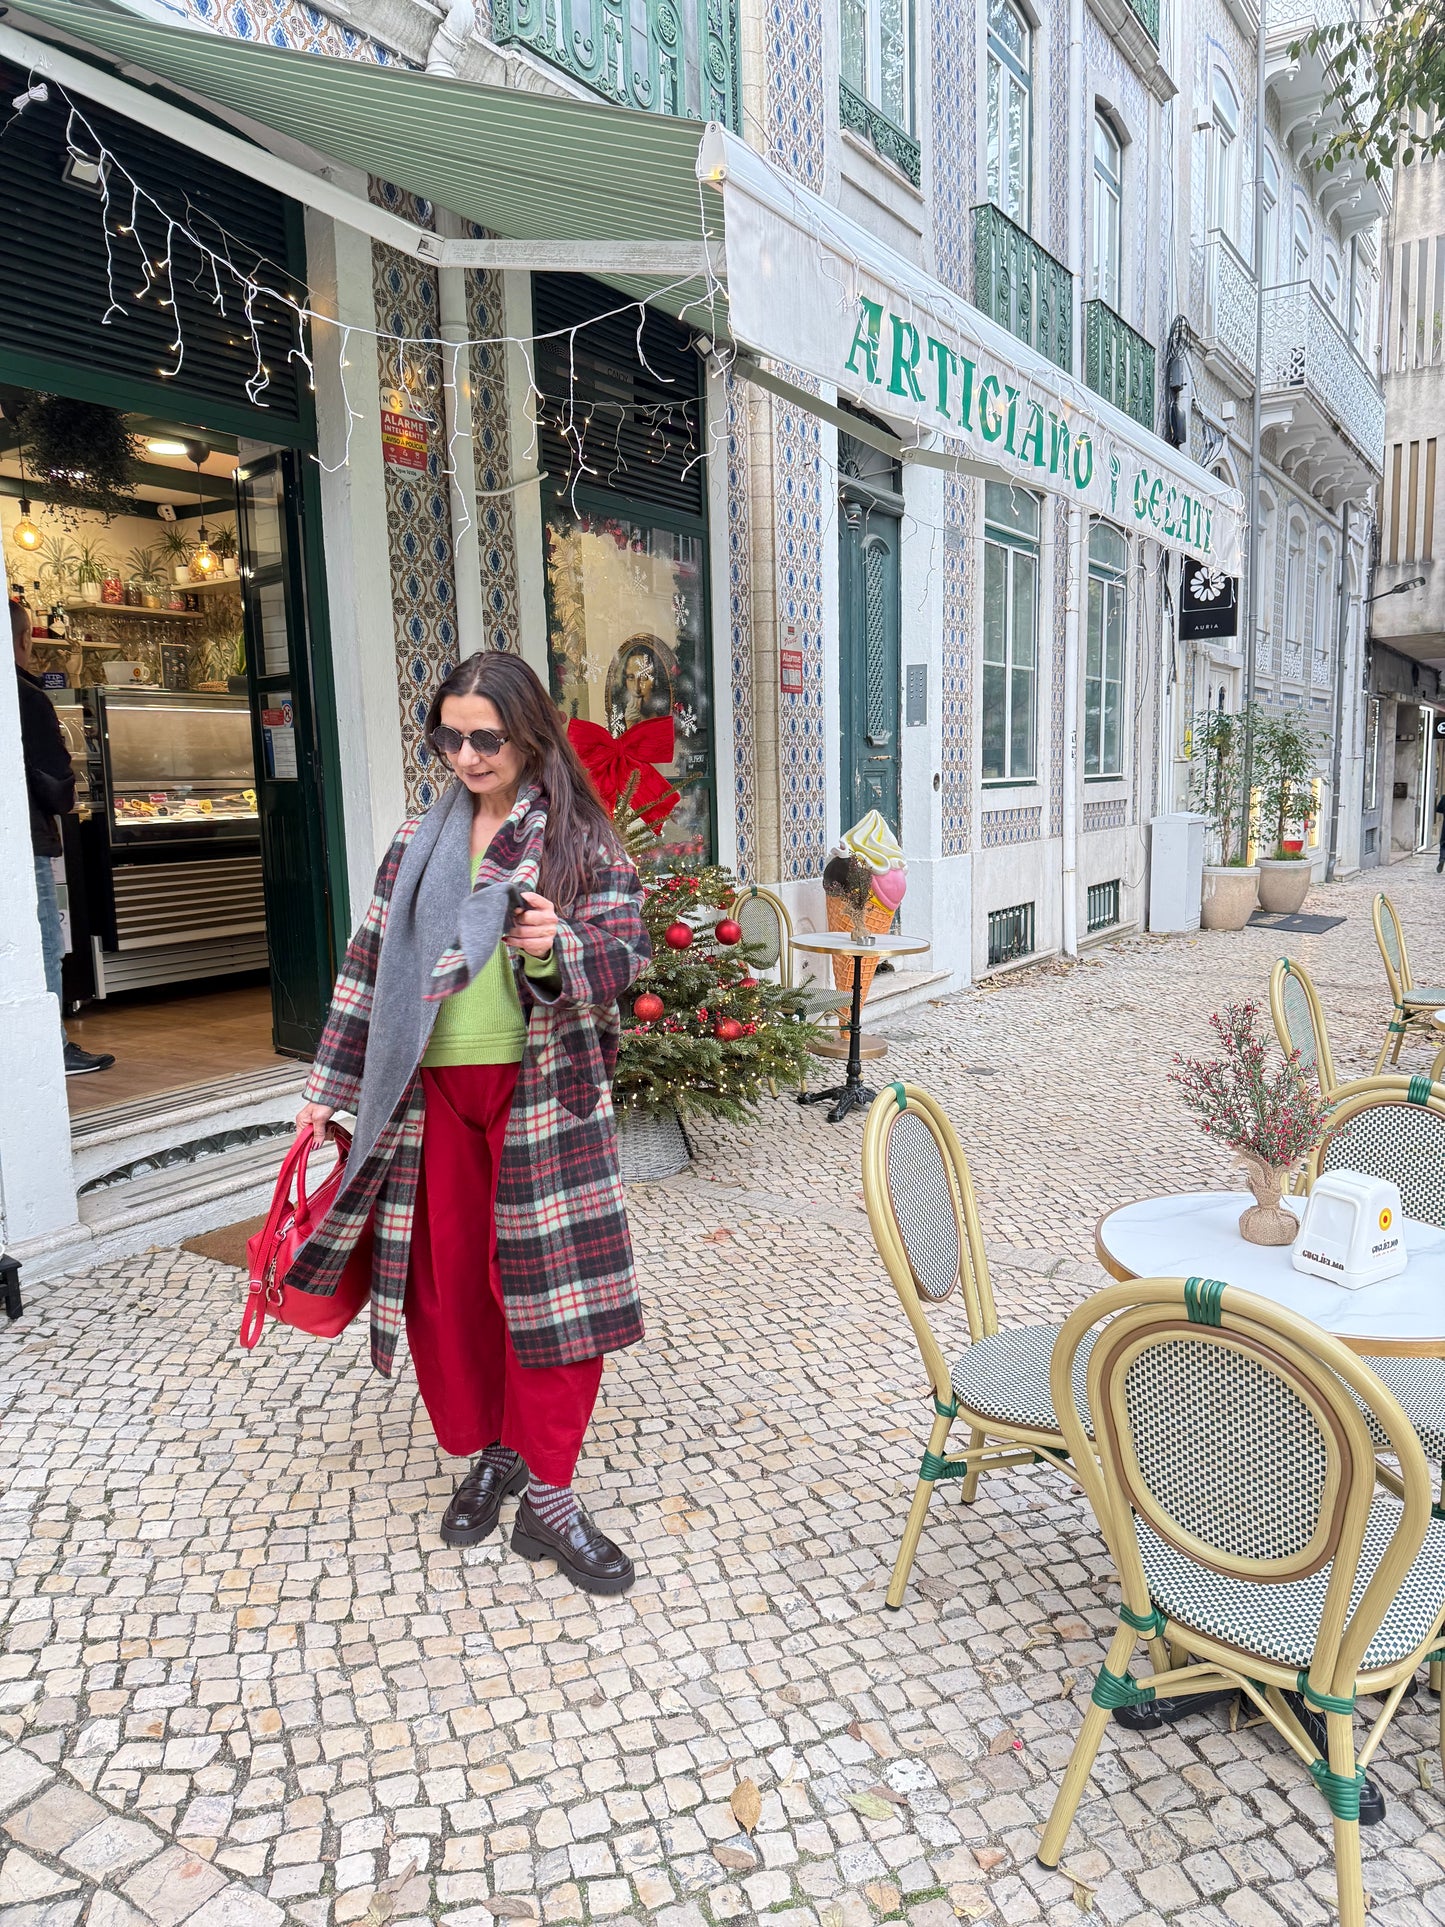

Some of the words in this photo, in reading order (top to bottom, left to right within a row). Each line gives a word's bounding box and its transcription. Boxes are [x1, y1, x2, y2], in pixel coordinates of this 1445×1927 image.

[844, 295, 1093, 489] ARTIGIANO
[382, 394, 403, 409] NOS
[384, 413, 424, 433] ALARME
[384, 424, 424, 441] INTELIGENTE
[386, 435, 400, 445] AVISO
[405, 440, 424, 451] POLÍCIA
[1133, 469, 1213, 554] GELATI
[1194, 623, 1219, 631] AURIA
[782, 652, 802, 664] Alarme
